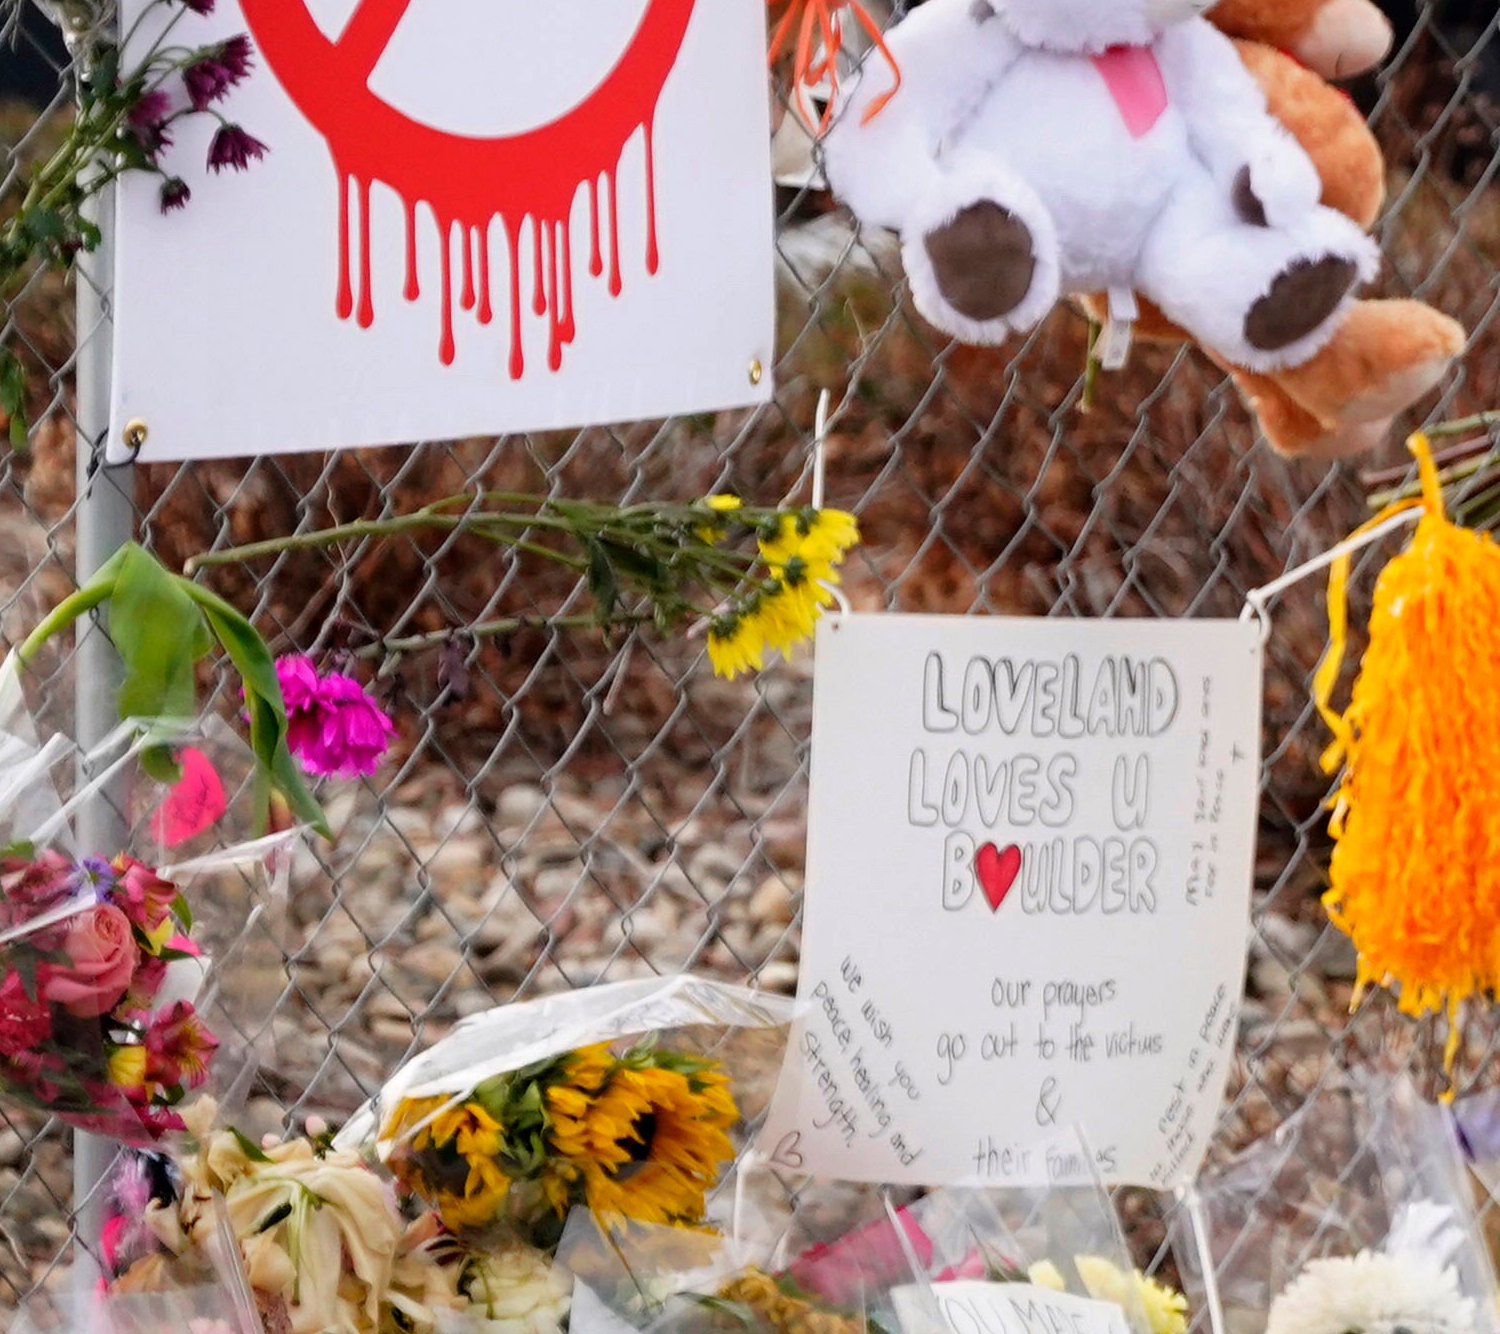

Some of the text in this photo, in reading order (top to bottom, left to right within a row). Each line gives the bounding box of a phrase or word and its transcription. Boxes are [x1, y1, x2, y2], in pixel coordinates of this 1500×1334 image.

[921, 650, 1180, 738] LOVELAND
[907, 747, 1151, 832] LOVES U
[1043, 978, 1117, 1027] prayers
[861, 999, 893, 1048] wish
[888, 1060, 920, 1100] you
[936, 1033, 966, 1085] go
[981, 1022, 1019, 1061] out
[1033, 1022, 1055, 1059] to
[1065, 1024, 1095, 1063] the
[850, 1046, 892, 1138] healing
[890, 1132, 924, 1166] and
[1036, 1075, 1062, 1127] &
[972, 1136, 1031, 1177] their
